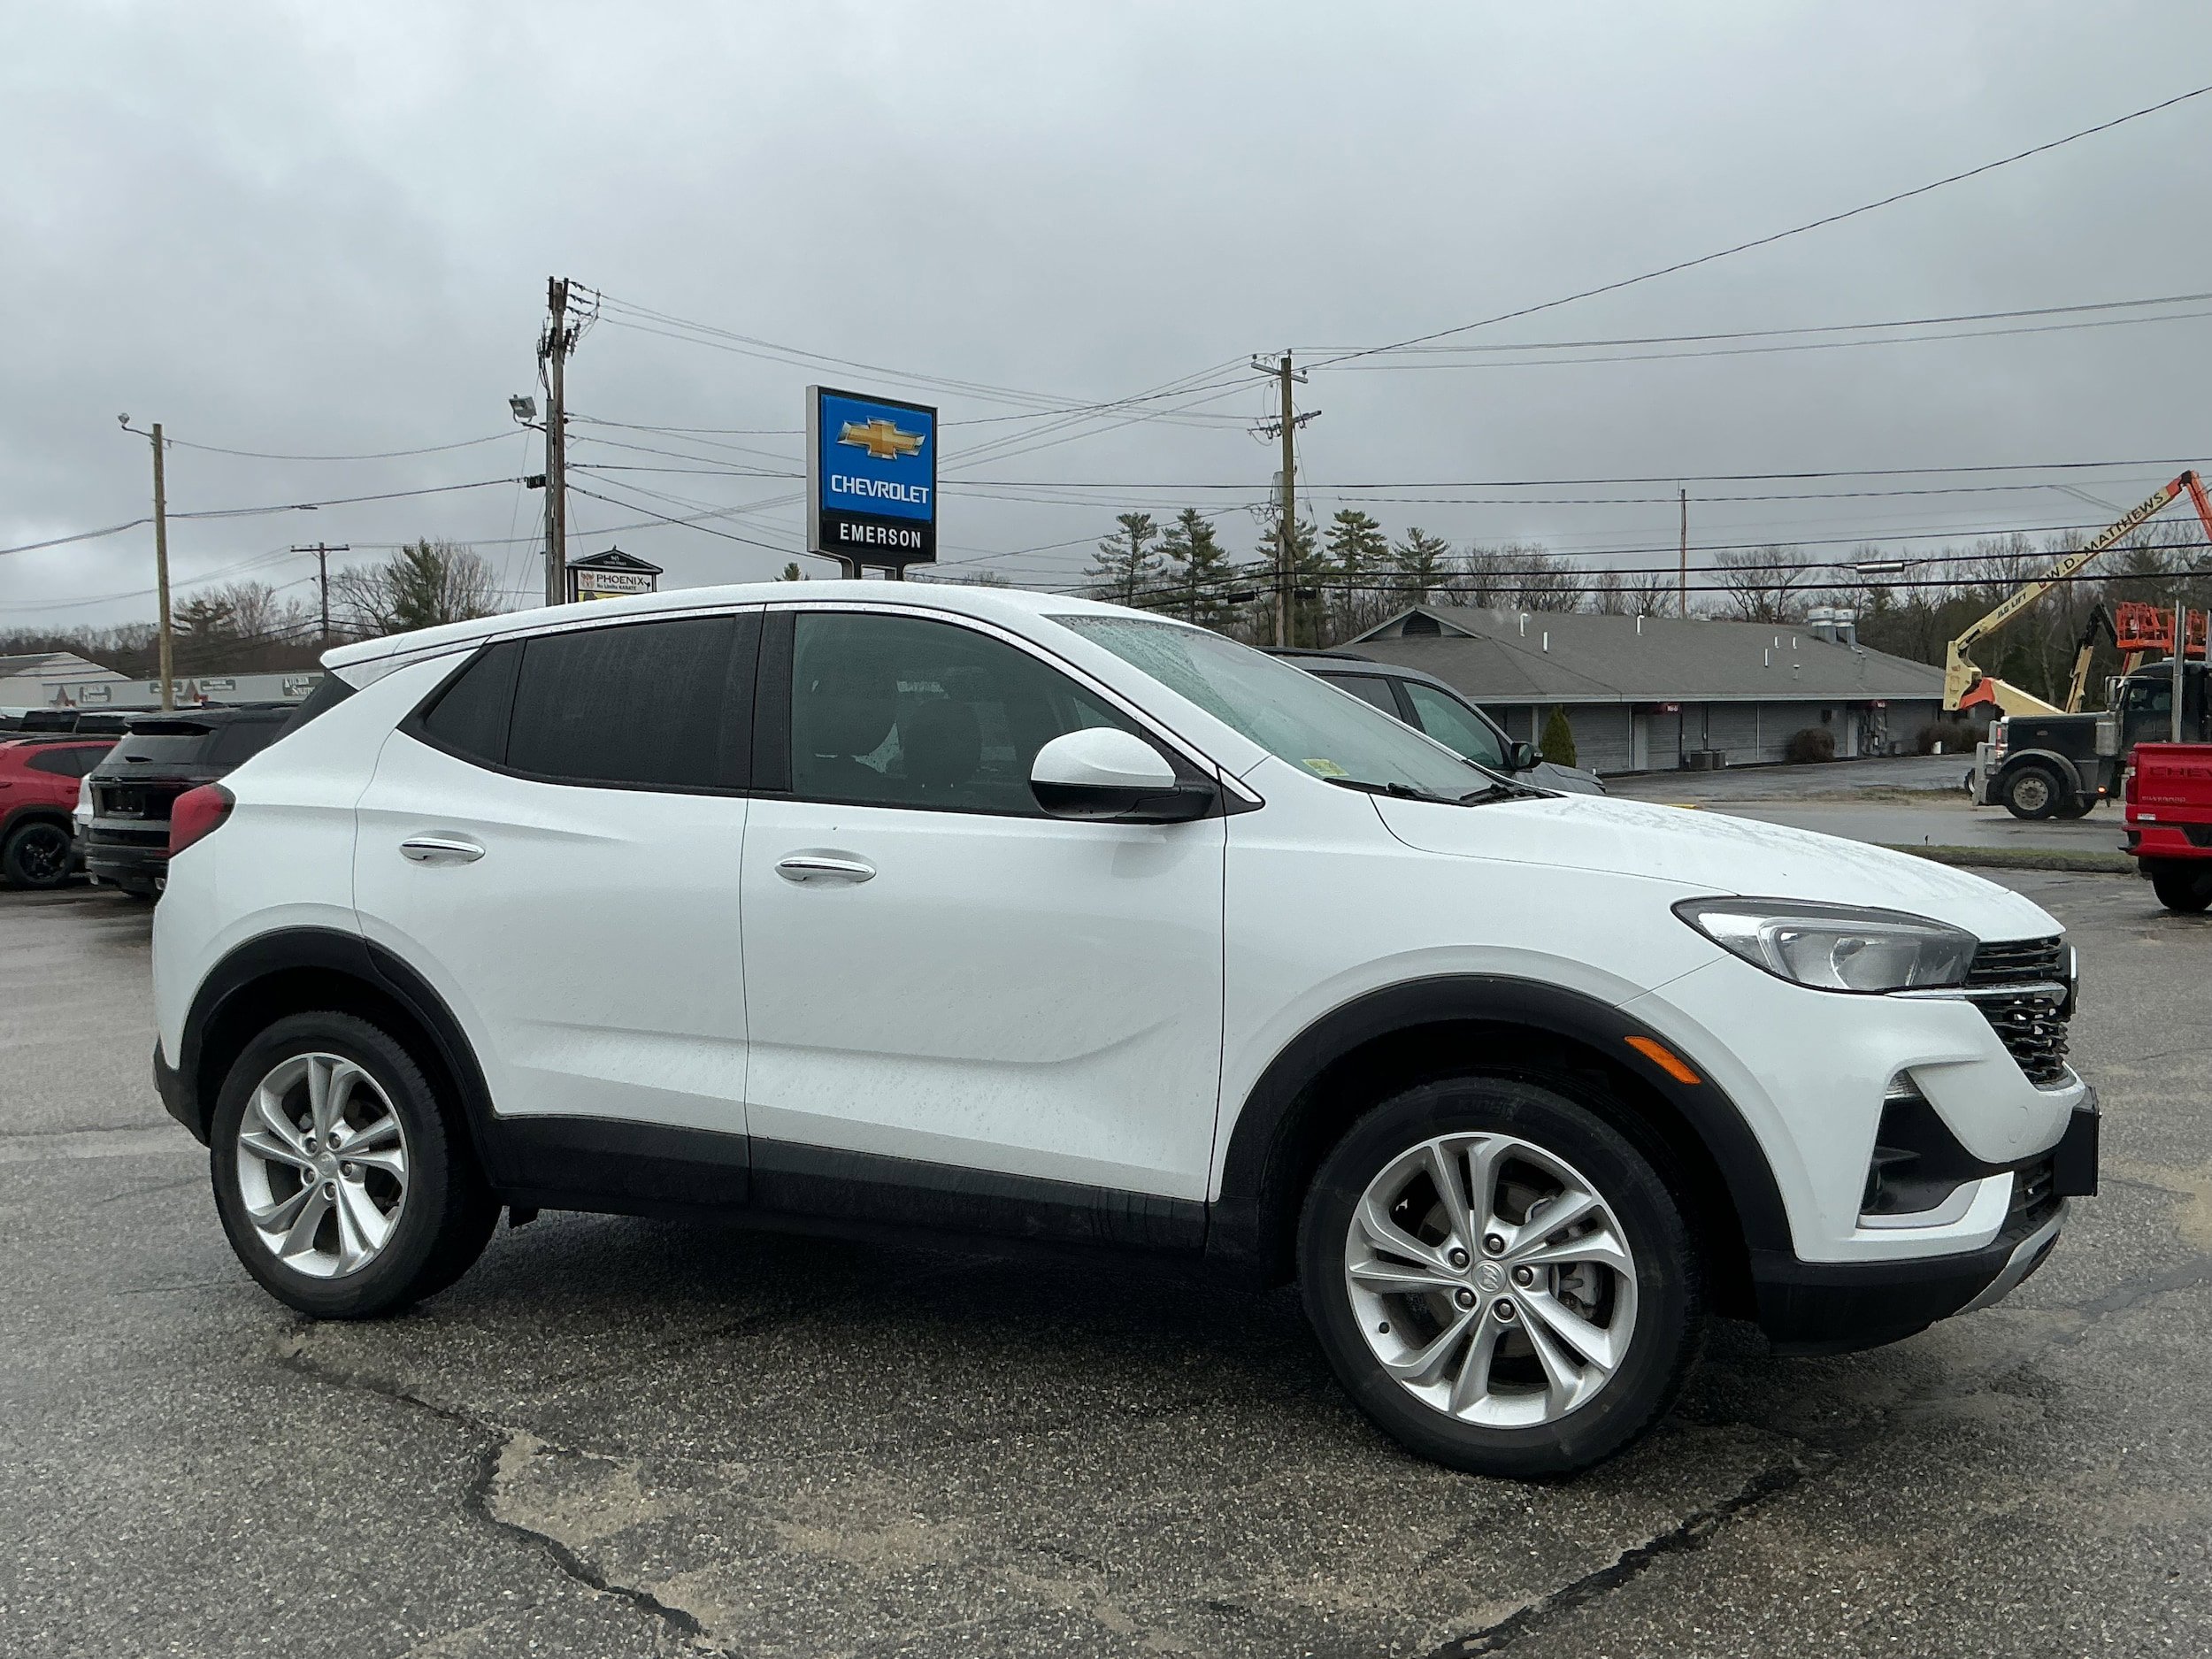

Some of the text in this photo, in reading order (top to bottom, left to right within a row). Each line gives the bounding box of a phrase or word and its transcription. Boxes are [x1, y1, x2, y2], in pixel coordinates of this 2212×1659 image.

[831, 474, 929, 504] CHEVROLET
[840, 522, 921, 549] EMERSON
[2083, 492, 2163, 557] MATTHEWS
[596, 574, 644, 586] PHOENIX
[1997, 591, 2027, 619] JLG LIFT
